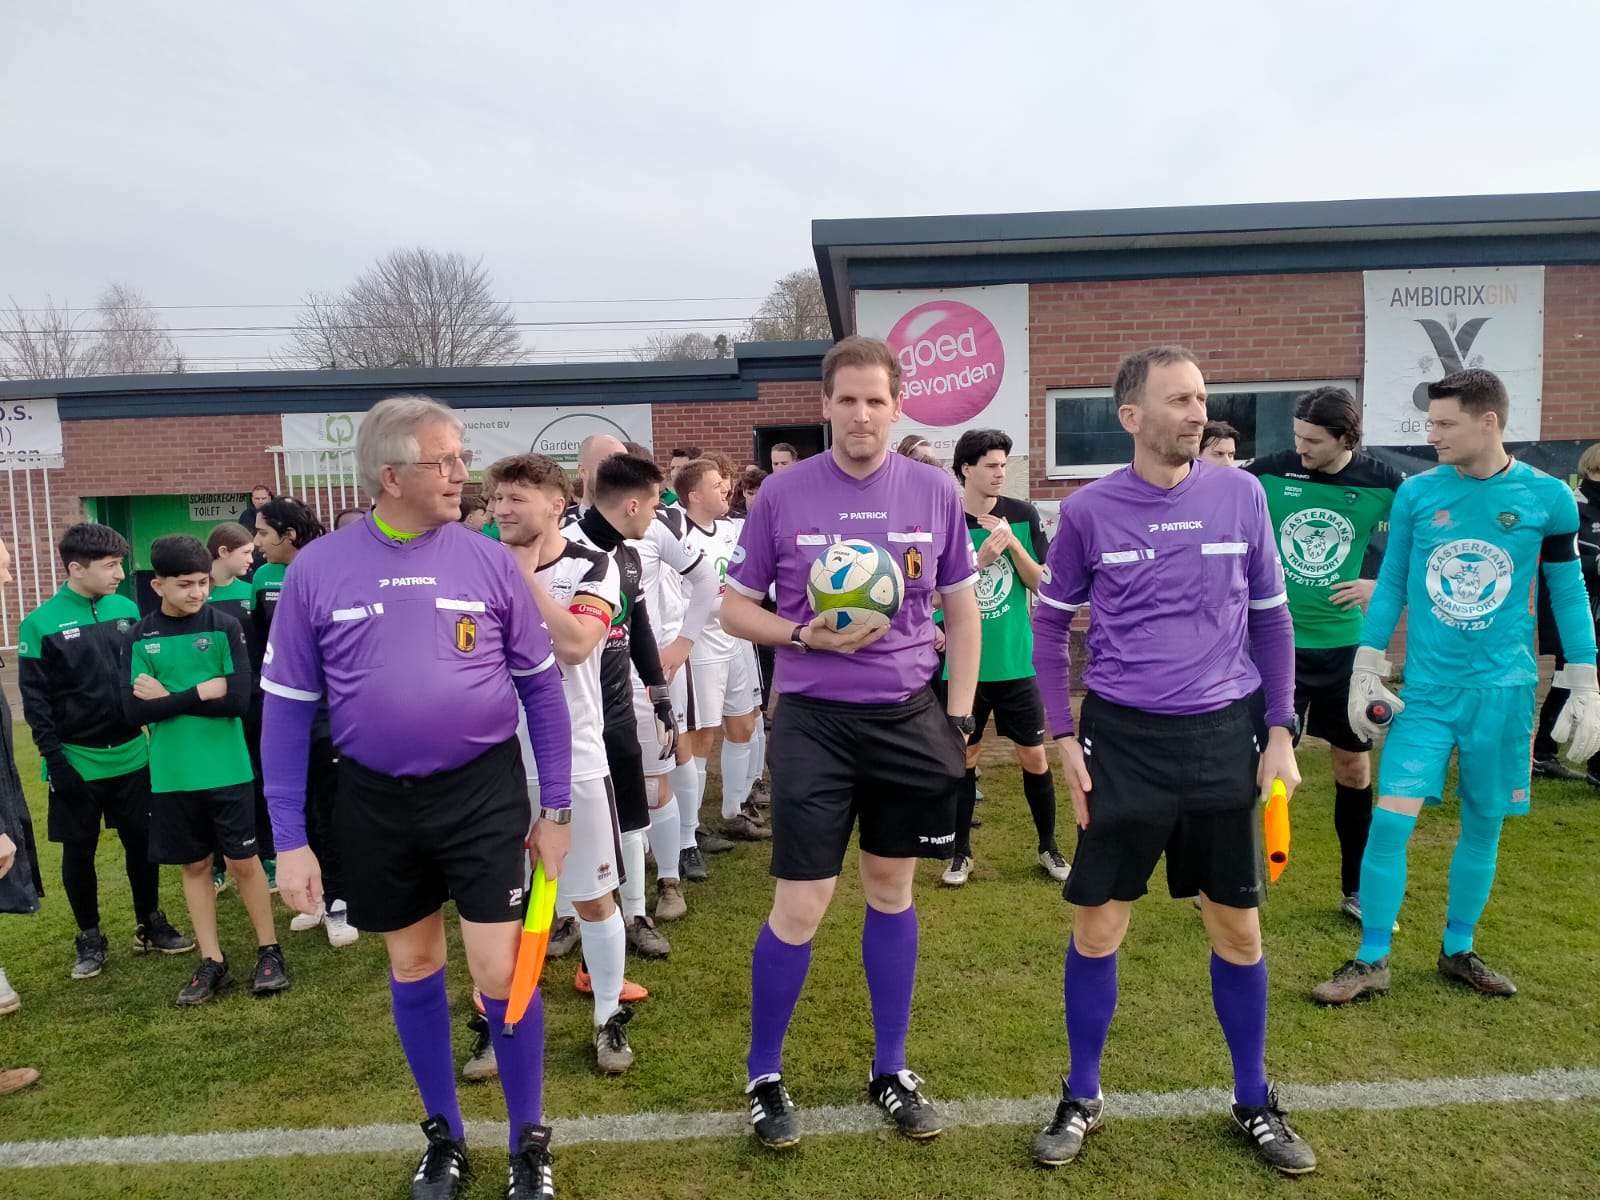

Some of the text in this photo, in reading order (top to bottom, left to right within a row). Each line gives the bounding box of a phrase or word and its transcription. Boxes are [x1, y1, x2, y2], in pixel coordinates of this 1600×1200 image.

[898, 327, 977, 377] goed
[540, 439, 581, 451] Garden
[193, 506, 221, 517] TOILET
[850, 511, 888, 521] PATRICK
[1161, 520, 1203, 532] PATRICK
[1286, 511, 1350, 543] CASTERMANS
[1288, 552, 1340, 572] TRANSPORT
[1433, 542, 1508, 577] CASTERMANS
[392, 576, 438, 587] PATRICK
[977, 592, 1006, 608] NSPORT
[1433, 592, 1497, 614] TRANSPORT
